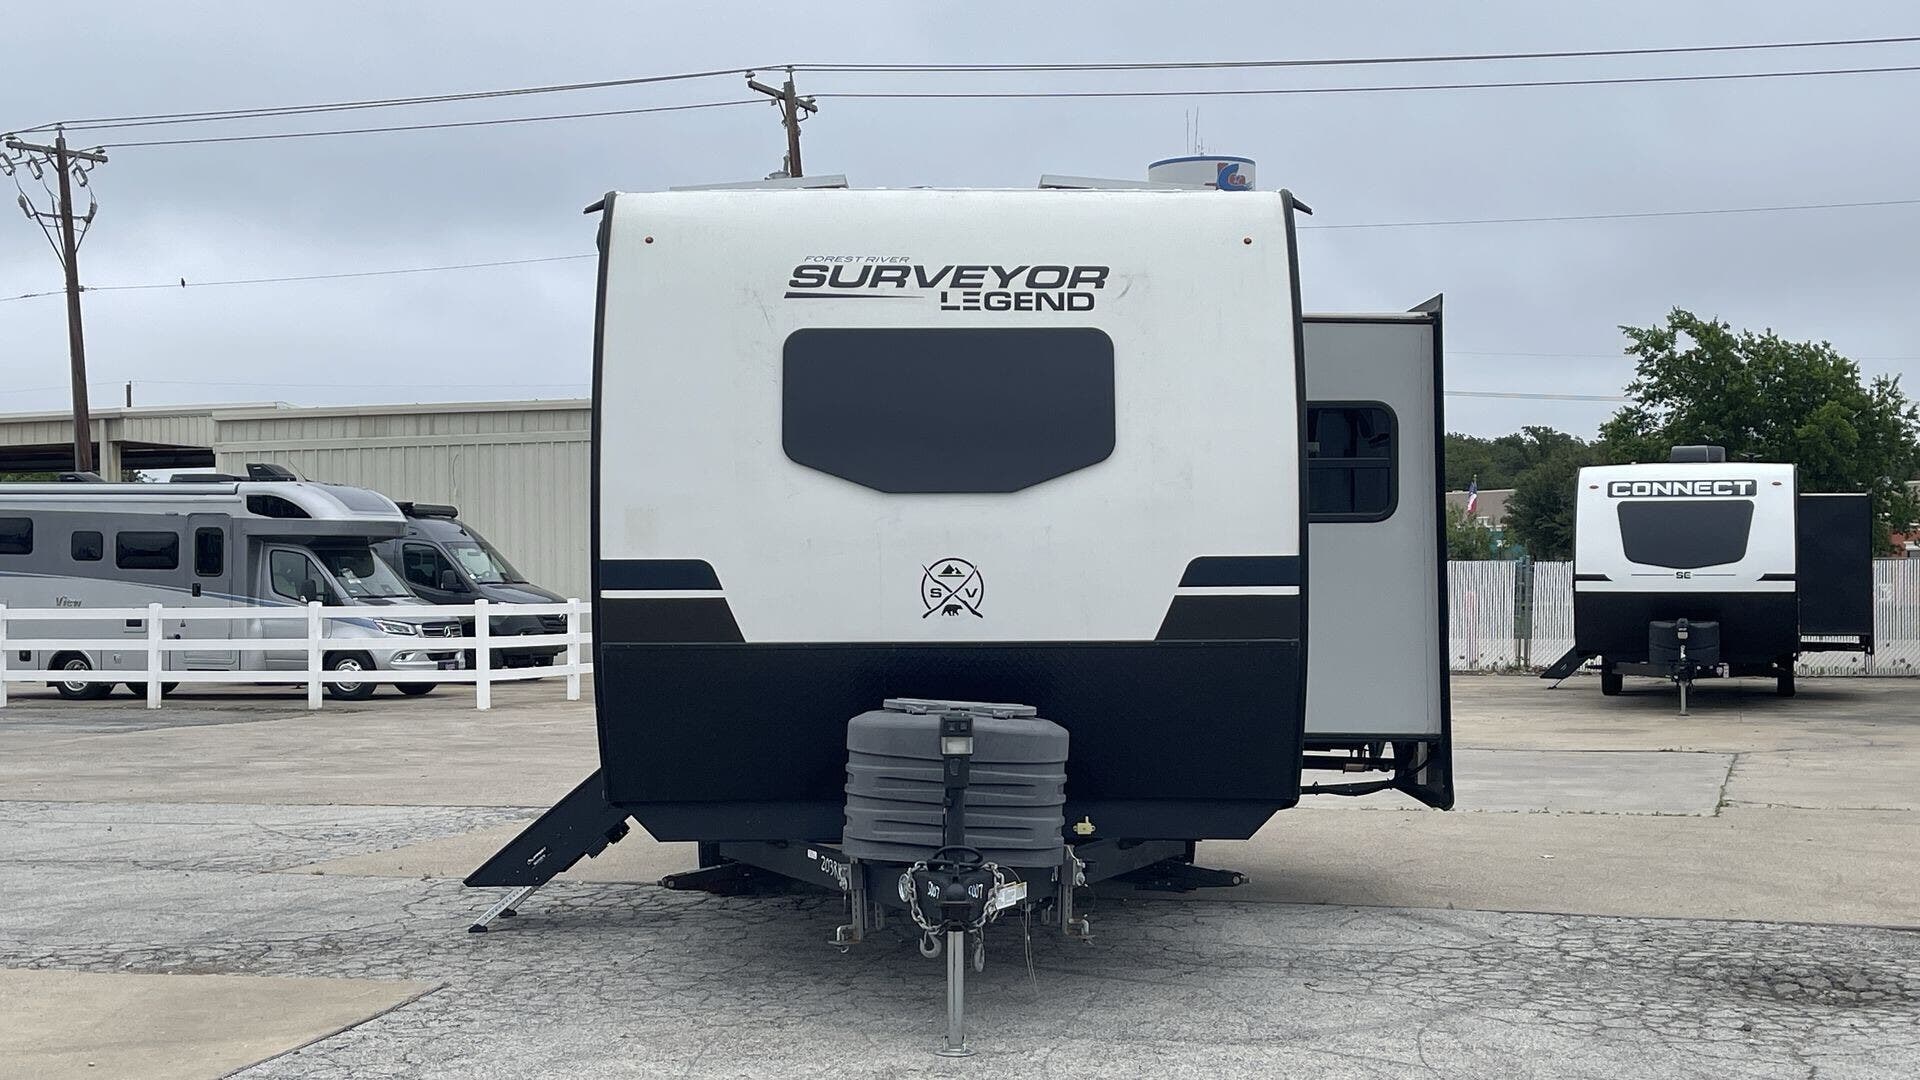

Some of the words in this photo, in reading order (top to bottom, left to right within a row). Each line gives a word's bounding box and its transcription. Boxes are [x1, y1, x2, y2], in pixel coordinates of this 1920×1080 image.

[804, 255, 863, 263] FOREST
[788, 264, 1110, 289] SURVEYOR
[940, 291, 1095, 311] LEGEND
[1612, 481, 1753, 496] CONNECT
